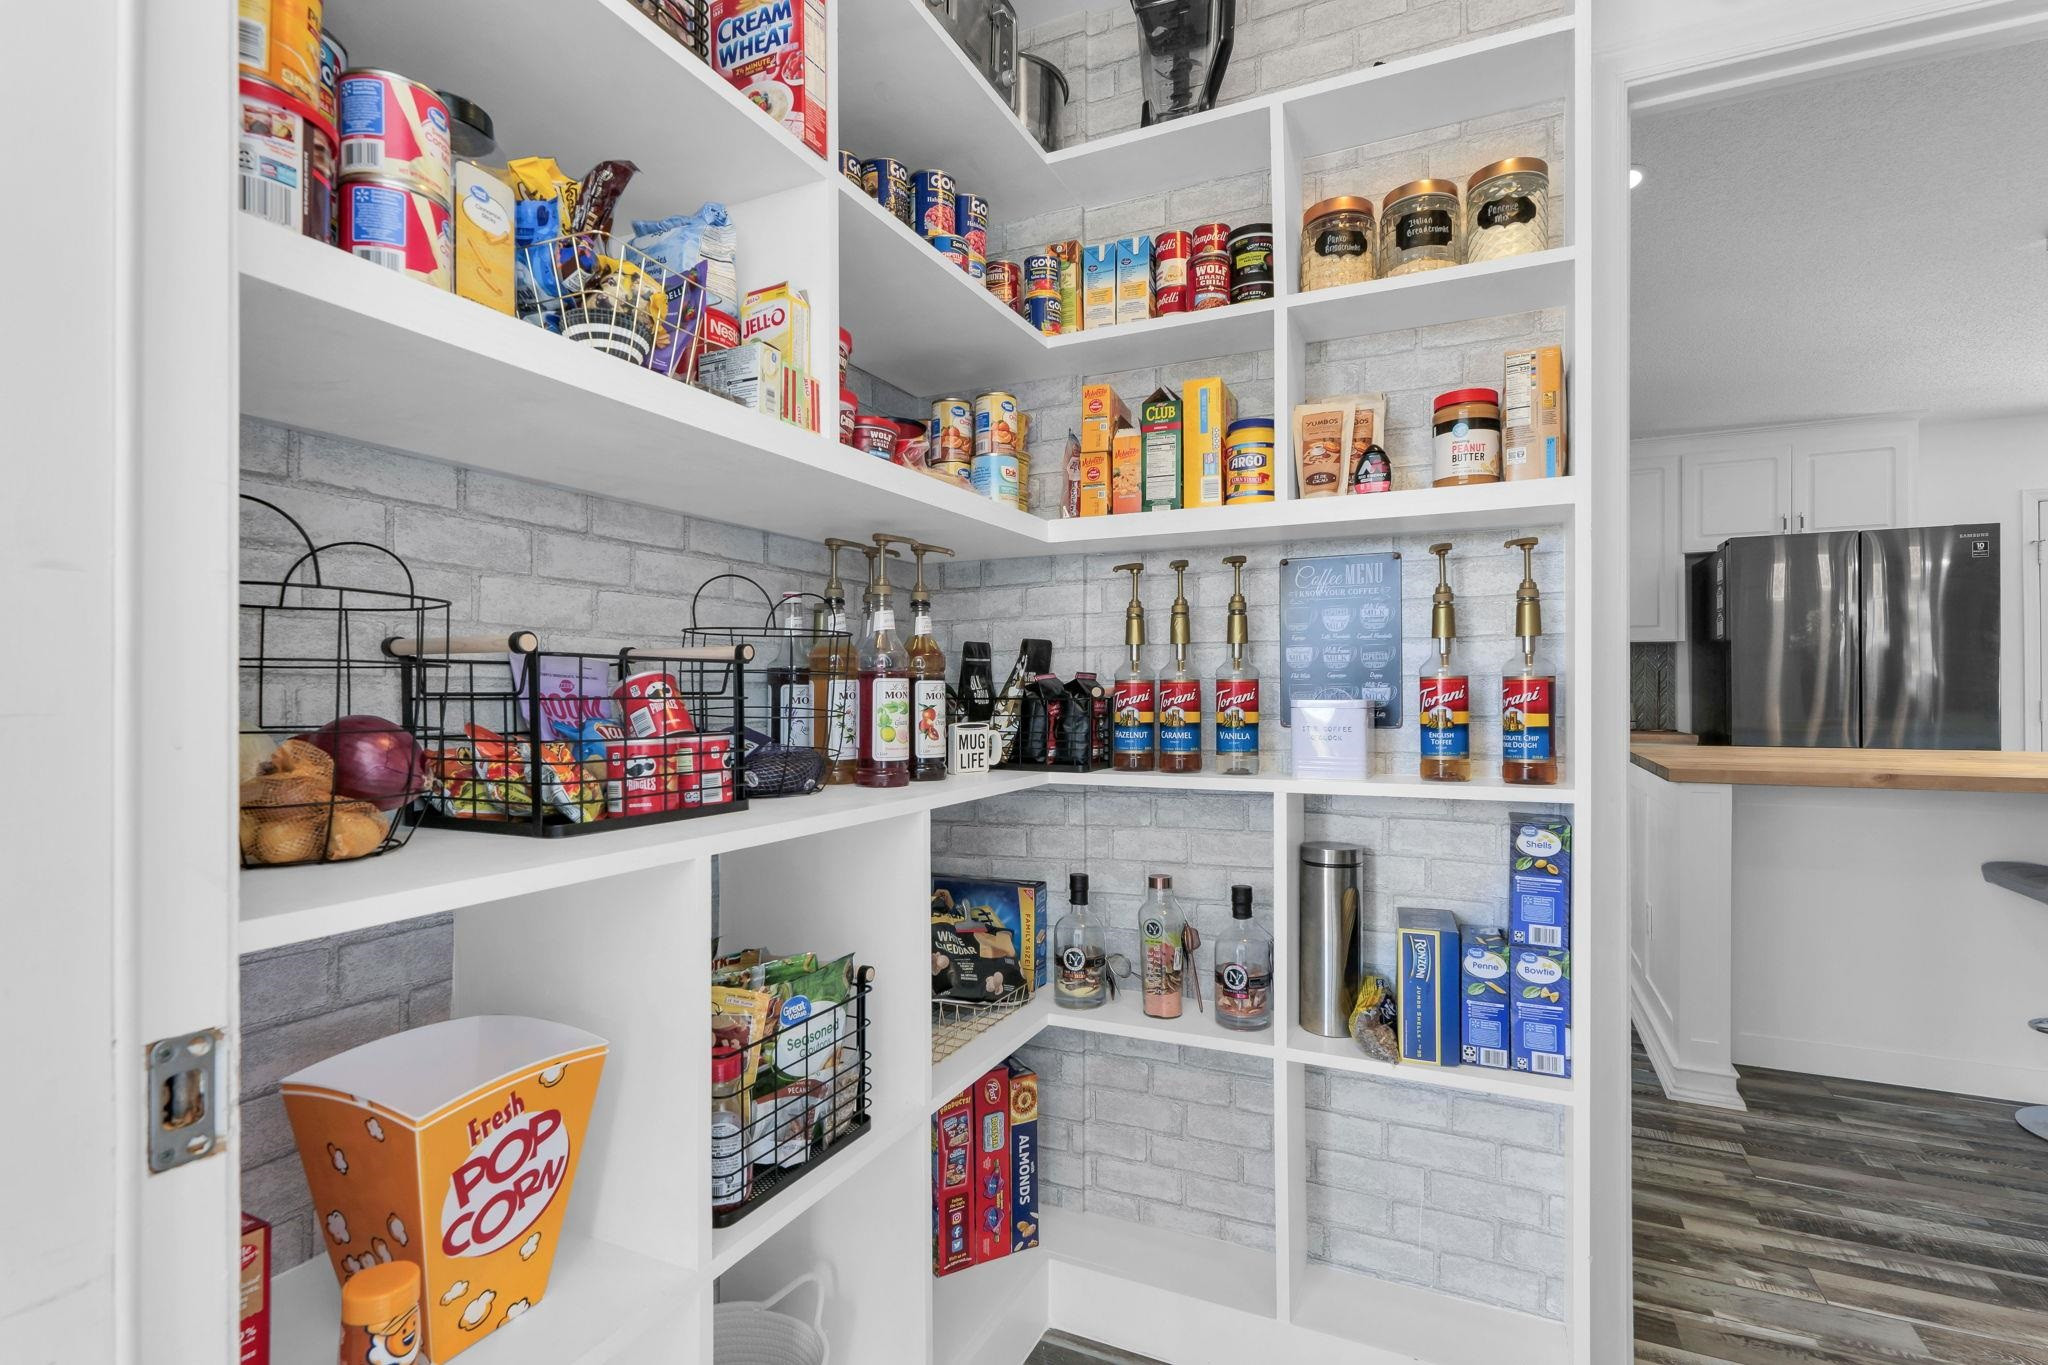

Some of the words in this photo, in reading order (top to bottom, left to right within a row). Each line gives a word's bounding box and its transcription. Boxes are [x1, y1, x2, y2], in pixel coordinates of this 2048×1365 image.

[718, 0, 792, 43] CREAM
[718, 23, 792, 68] WHEAT
[1488, 202, 1519, 216] Pancake
[1409, 217, 1432, 228] Italian
[1495, 212, 1510, 223] Mix
[1327, 235, 1347, 244] Panko
[1031, 258, 1057, 268] GOYA
[1196, 264, 1228, 277] WOLF
[1048, 300, 1061, 310] GO
[1146, 405, 1176, 421] CLUB
[1306, 418, 1338, 427] YUMBOS
[870, 430, 892, 441] WOLF
[1452, 443, 1486, 454] PEANUT
[1231, 455, 1263, 470] ARGO
[1452, 452, 1485, 463] BUTTER
[1295, 565, 1343, 593] Coffee
[1345, 563, 1384, 585] MENU
[1299, 590, 1320, 598] KNOW
[1324, 589, 1346, 597] YOUR
[1347, 587, 1379, 595] COFFEE
[1115, 689, 1150, 712] Torani
[1160, 688, 1196, 712] Torani
[1216, 687, 1256, 712] Torani
[1420, 685, 1465, 712] Torani
[959, 733, 985, 751] MUG
[1161, 731, 1192, 739] CARAMEL
[1219, 731, 1250, 740] VANILLA
[1431, 738, 1452, 746] TOFFEE
[1523, 734, 1539, 742] CHIP
[960, 752, 985, 769] LIFE
[1526, 840, 1552, 849] Shells
[937, 930, 966, 946] WHITE
[1068, 953, 1083, 967] NY
[1414, 938, 1427, 979] RONZONI
[1472, 961, 1499, 971] Penne
[1229, 970, 1243, 985] NY
[1524, 966, 1555, 976] Bowtie
[783, 1001, 806, 1017] Great
[788, 1009, 807, 1021] Value
[787, 1018, 839, 1052] Seasoned
[988, 1082, 998, 1101] Post
[940, 1096, 971, 1115] PRODUCTS!
[467, 1090, 525, 1148] Fresh
[452, 1108, 562, 1209] POP
[1018, 1135, 1031, 1205] ALMONDS
[442, 1155, 565, 1256] CORN
